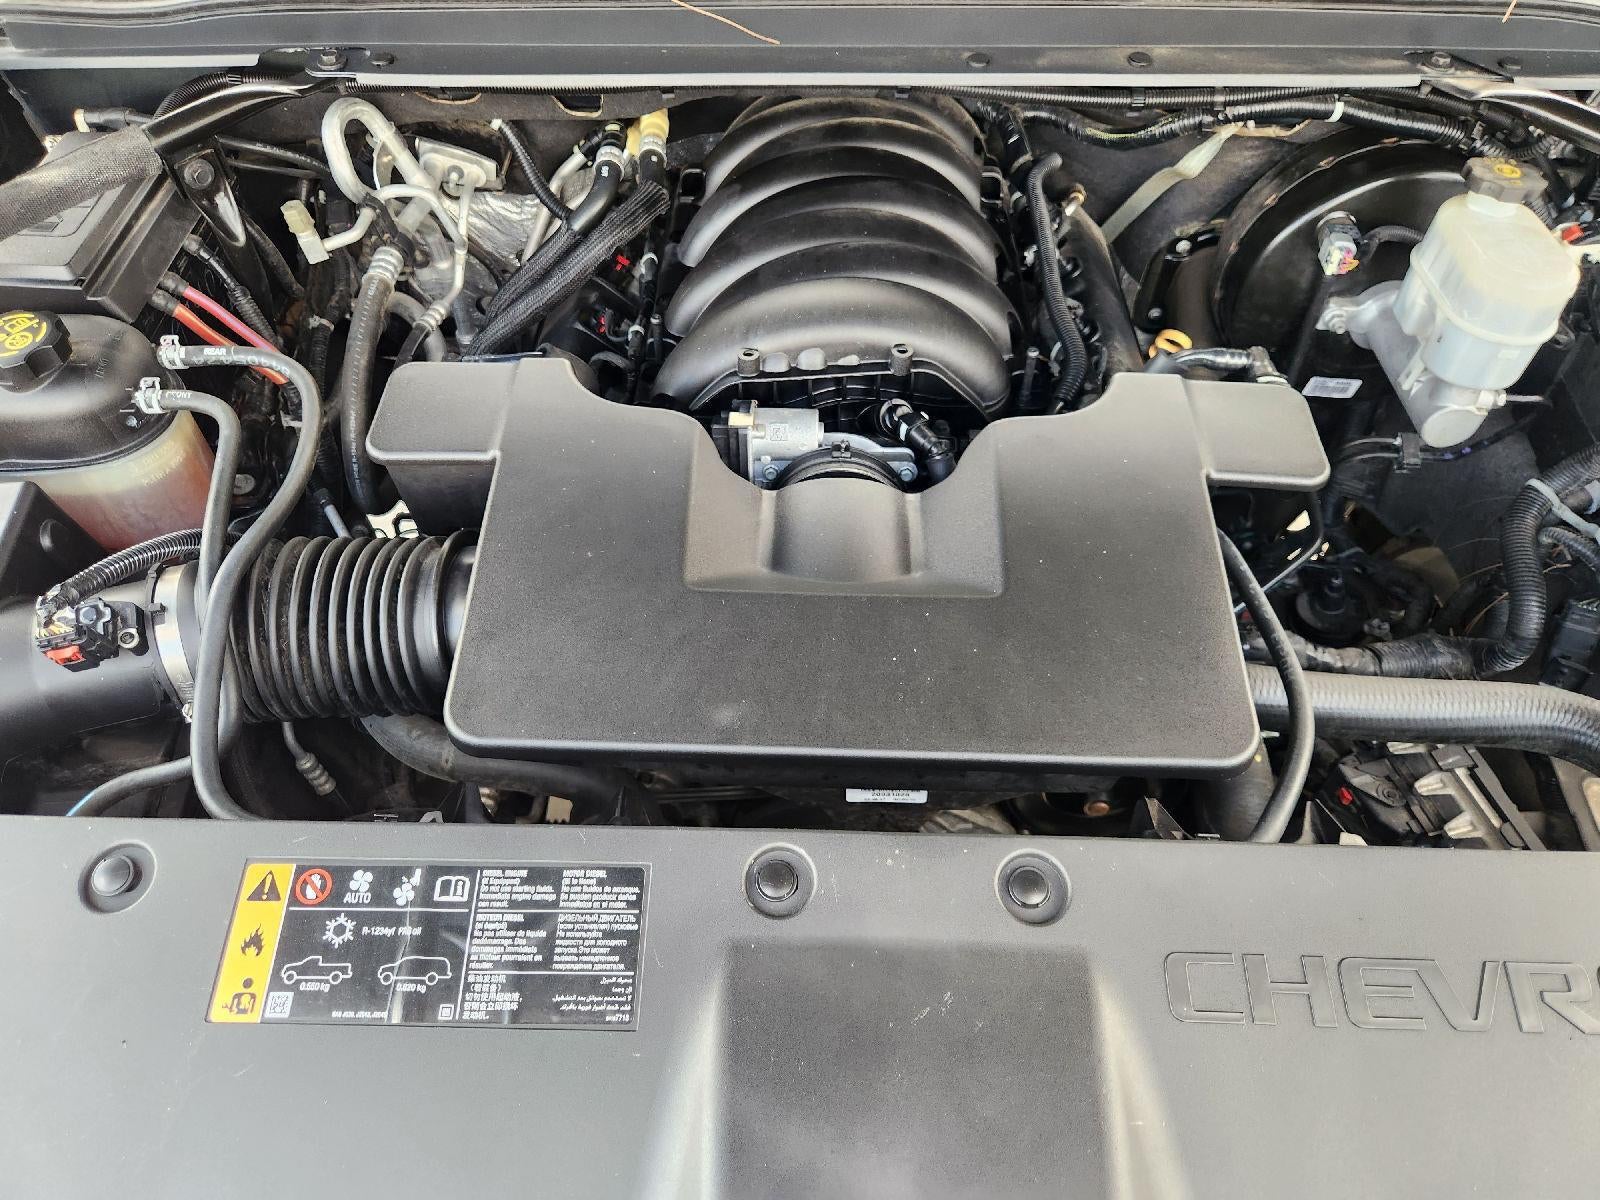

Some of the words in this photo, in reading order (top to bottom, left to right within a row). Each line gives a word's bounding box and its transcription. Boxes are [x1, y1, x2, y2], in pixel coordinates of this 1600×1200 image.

[203, 348, 226, 356] REAR
[343, 892, 371, 904] AUTO
[412, 927, 422, 936] oil
[320, 982, 331, 992] kg
[416, 983, 427, 994] kg
[1164, 951, 1600, 1036] CHEVR
